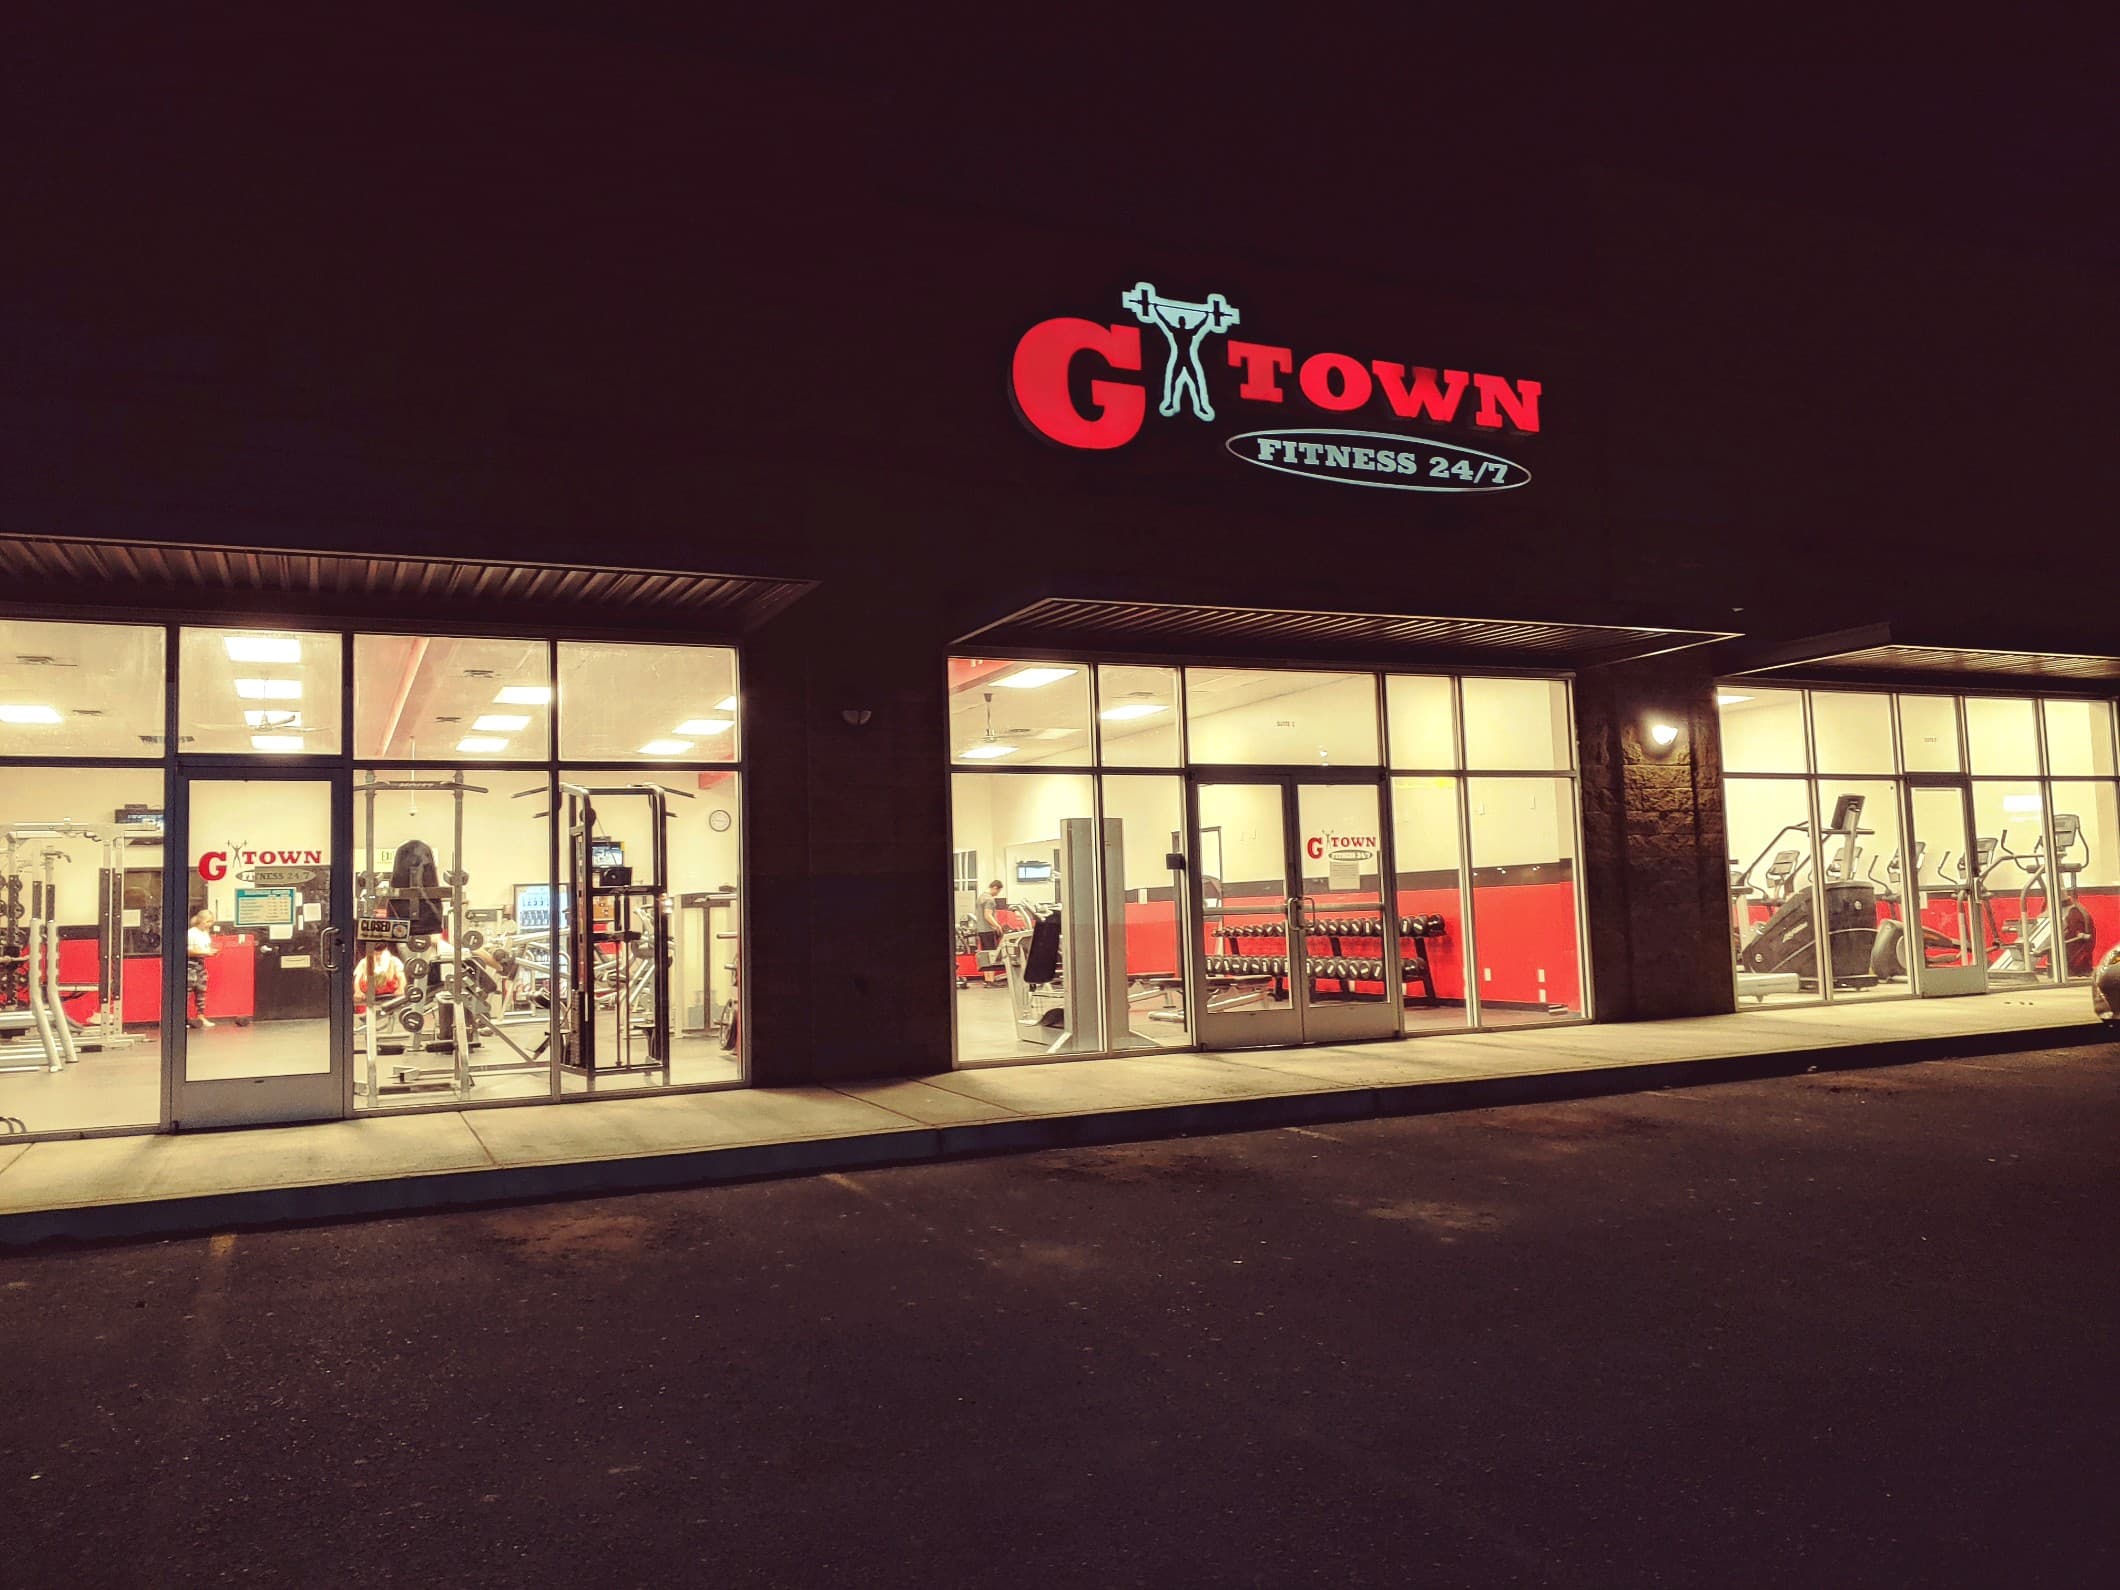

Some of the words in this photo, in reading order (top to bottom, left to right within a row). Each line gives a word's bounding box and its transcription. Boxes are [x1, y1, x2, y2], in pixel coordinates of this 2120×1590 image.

[1012, 317, 1146, 450] G
[1227, 340, 1541, 433] TOWN
[1257, 437, 1417, 475] FITNESS
[1428, 456, 1508, 484] 24/7
[1307, 837, 1324, 859] G
[1330, 836, 1376, 848] TOWN
[198, 851, 227, 881] G
[241, 850, 322, 865] TOWN
[360, 919, 392, 933] CLOSED
